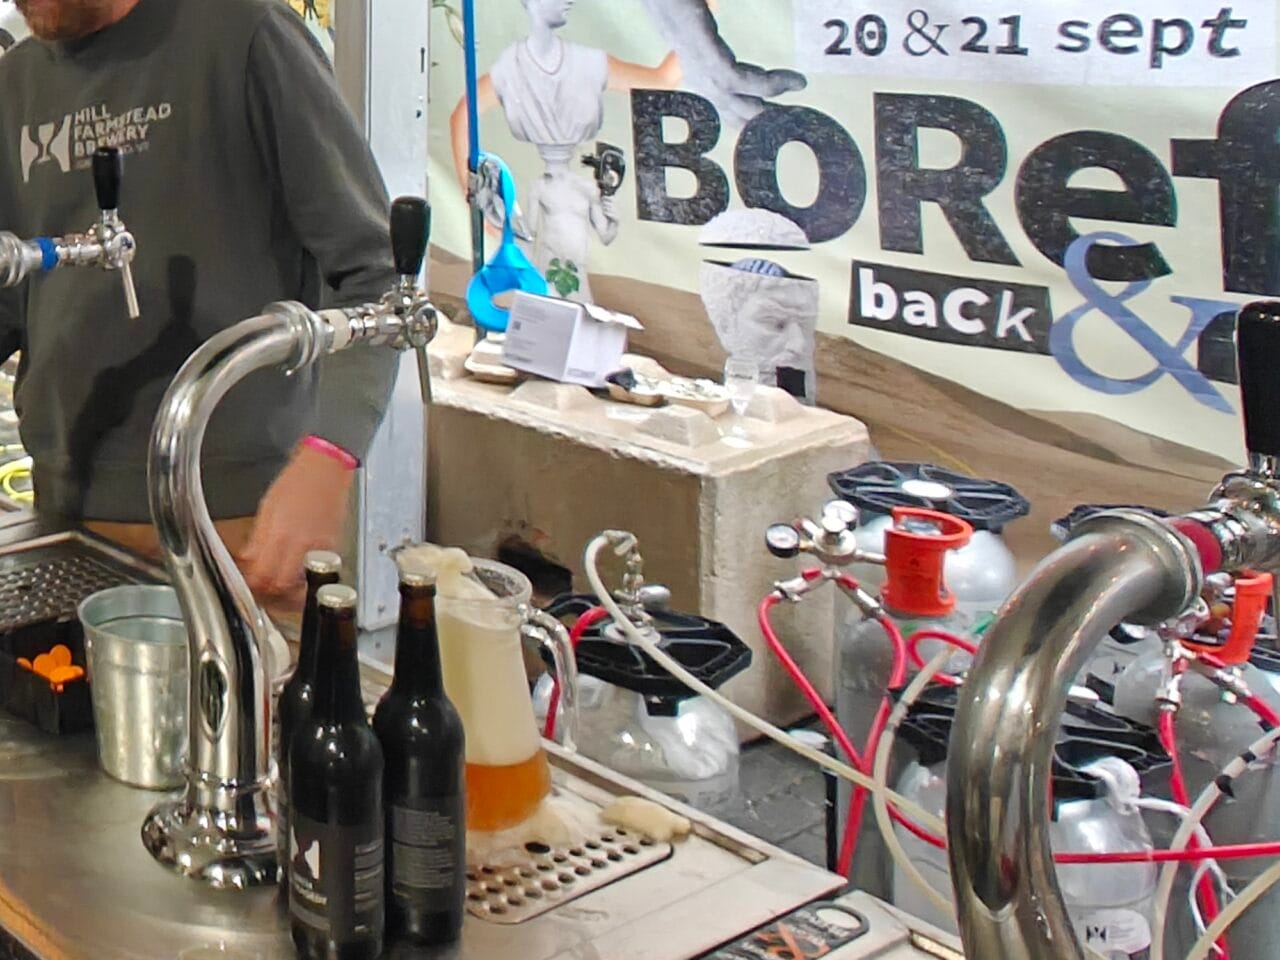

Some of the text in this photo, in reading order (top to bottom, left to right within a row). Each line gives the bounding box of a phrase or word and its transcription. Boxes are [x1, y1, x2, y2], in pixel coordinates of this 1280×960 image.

[823, 6, 1249, 70] 20 & 21 sept
[75, 103, 112, 125] HILL
